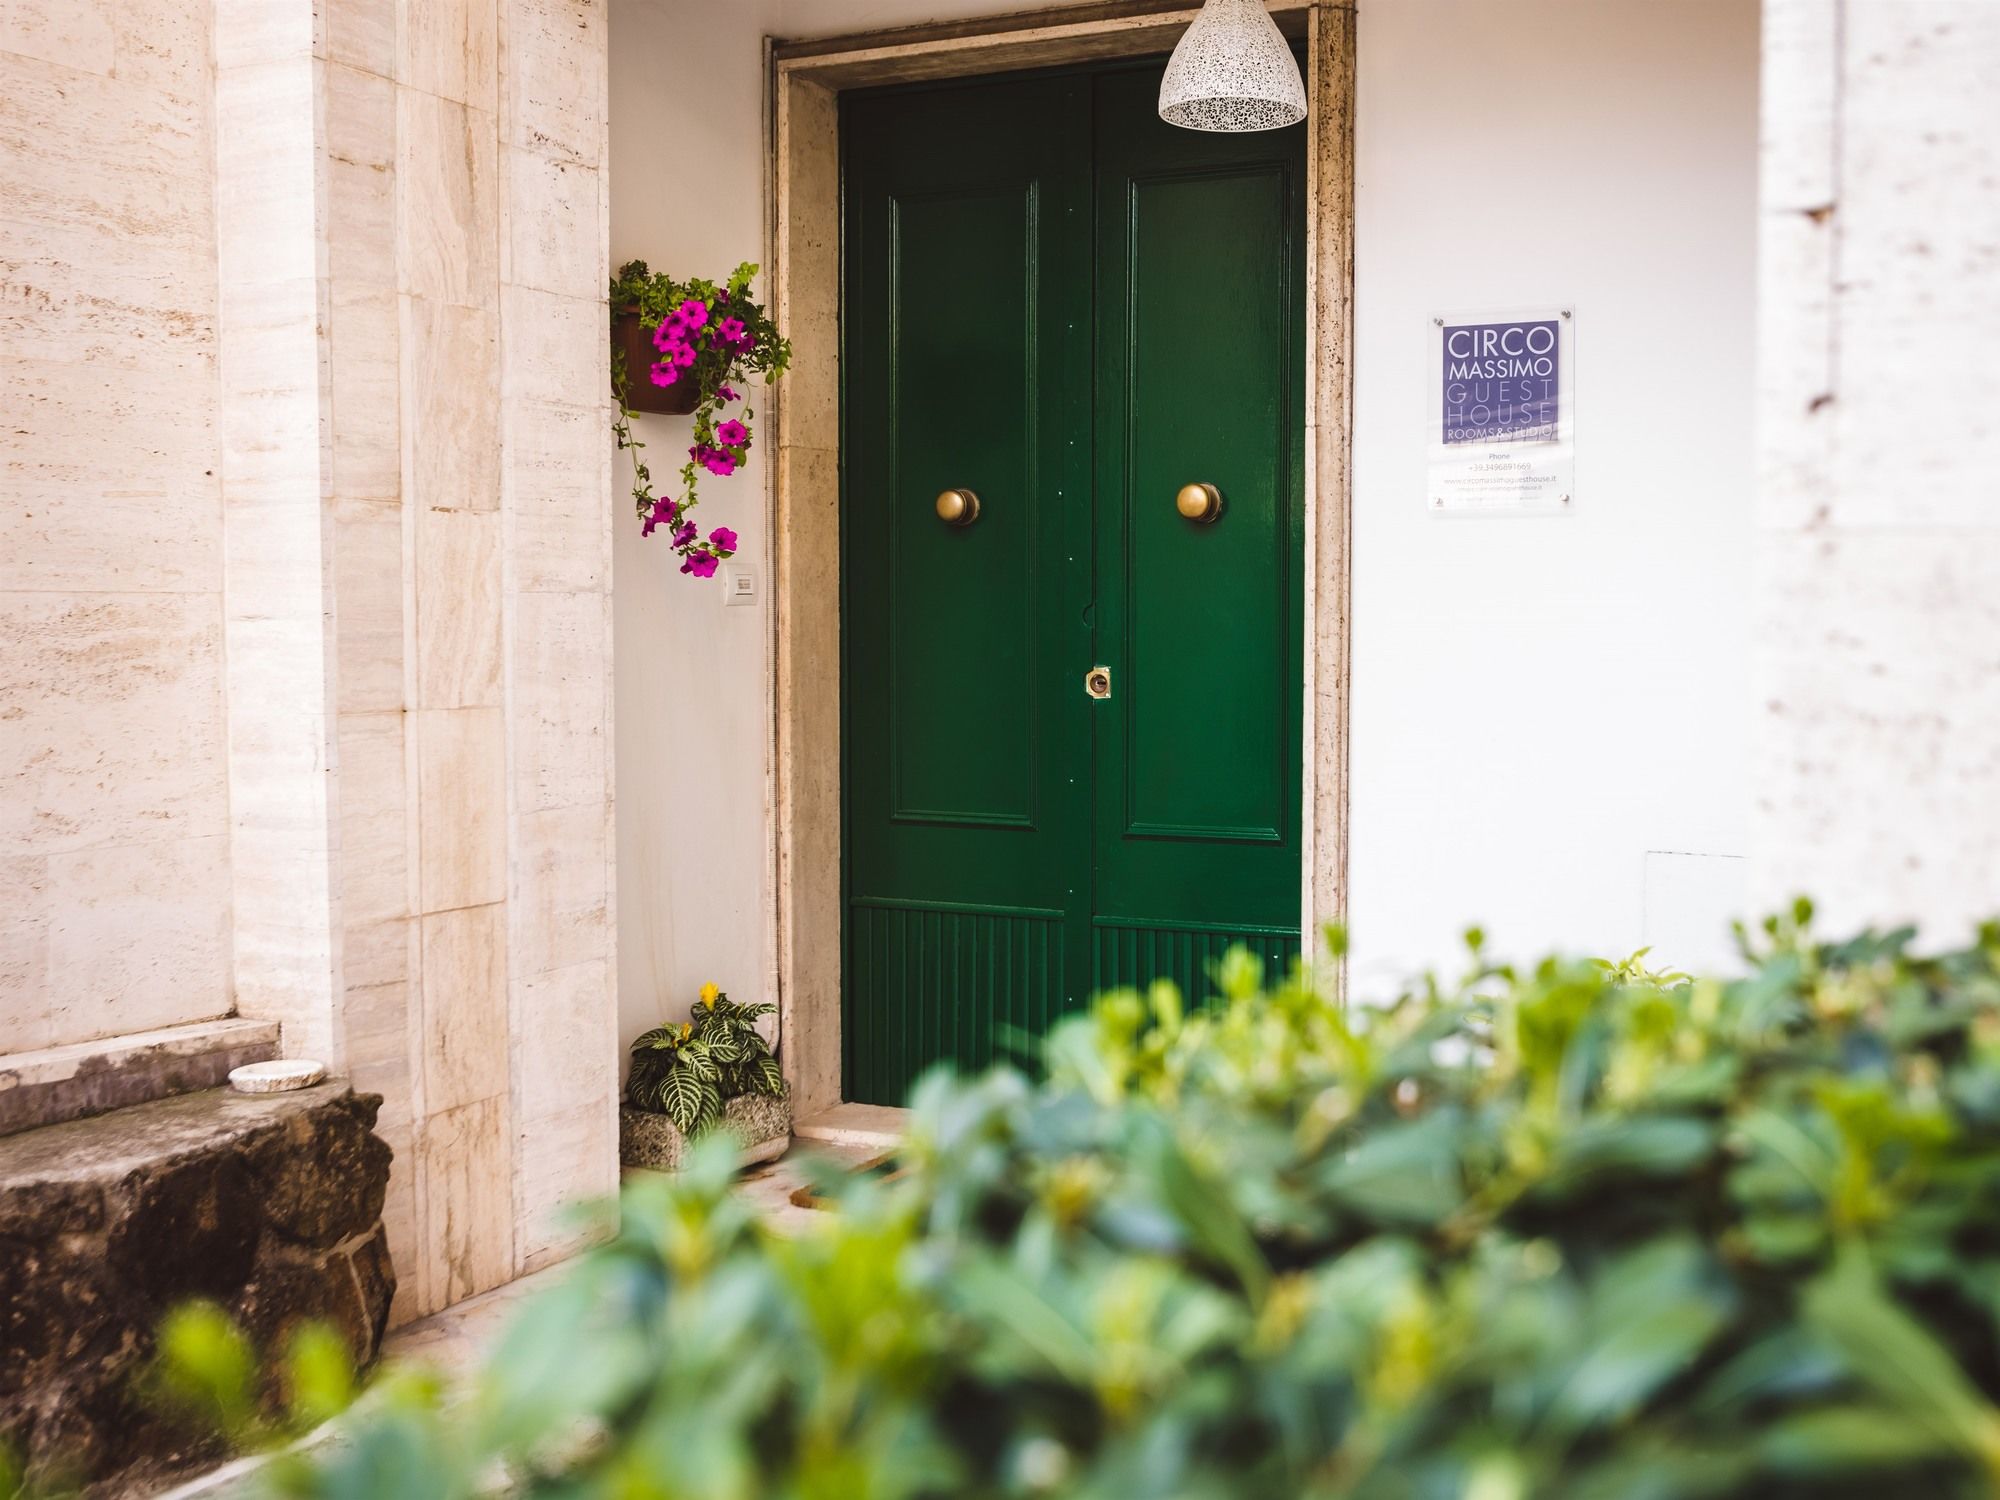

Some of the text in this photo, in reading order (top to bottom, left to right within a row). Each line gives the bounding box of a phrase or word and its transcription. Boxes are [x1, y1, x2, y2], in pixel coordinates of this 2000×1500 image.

[1448, 326, 1554, 358] CIRCO
[1449, 357, 1552, 380] MASSIMO
[1447, 380, 1552, 403] GUEST
[1447, 402, 1551, 426] HOUSE
